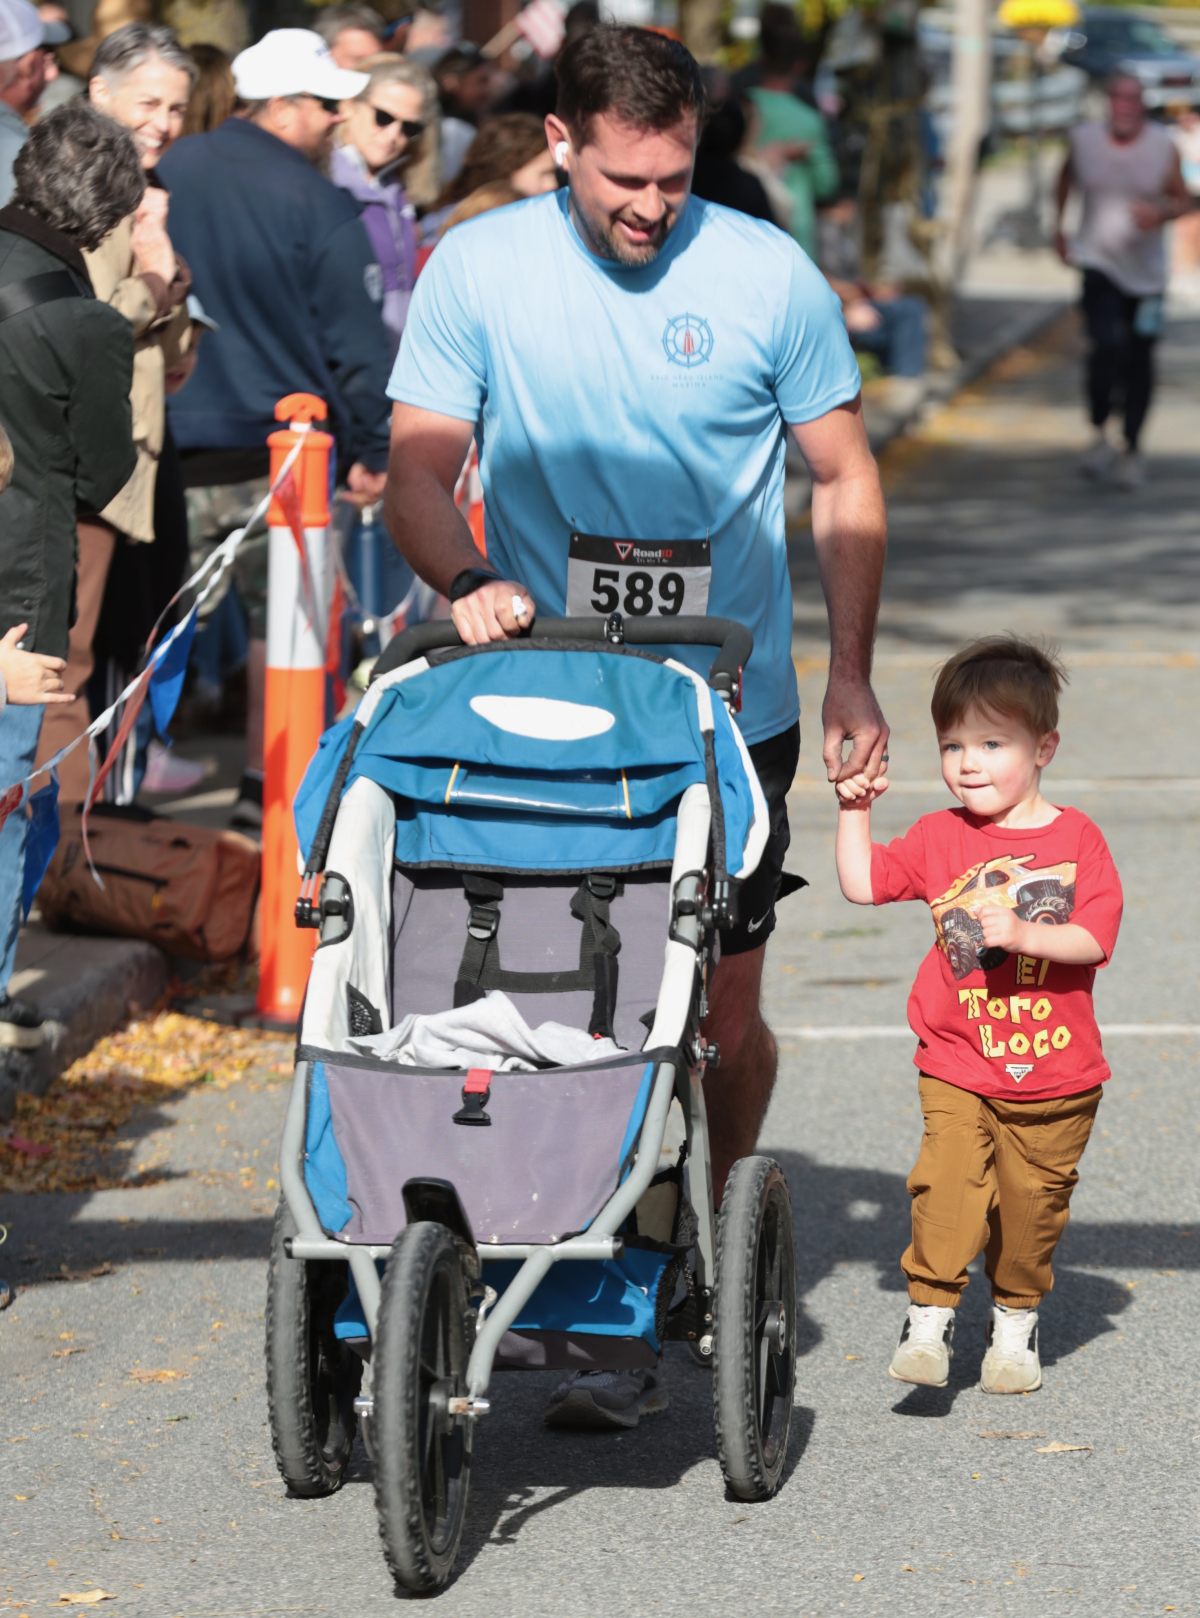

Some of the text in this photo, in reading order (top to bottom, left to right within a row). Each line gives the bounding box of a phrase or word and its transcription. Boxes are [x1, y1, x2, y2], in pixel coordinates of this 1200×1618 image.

[591, 568, 685, 616] 589
[1016, 955, 1050, 987] El
[958, 988, 1052, 1024] Toro
[978, 1024, 1071, 1058] Loco
